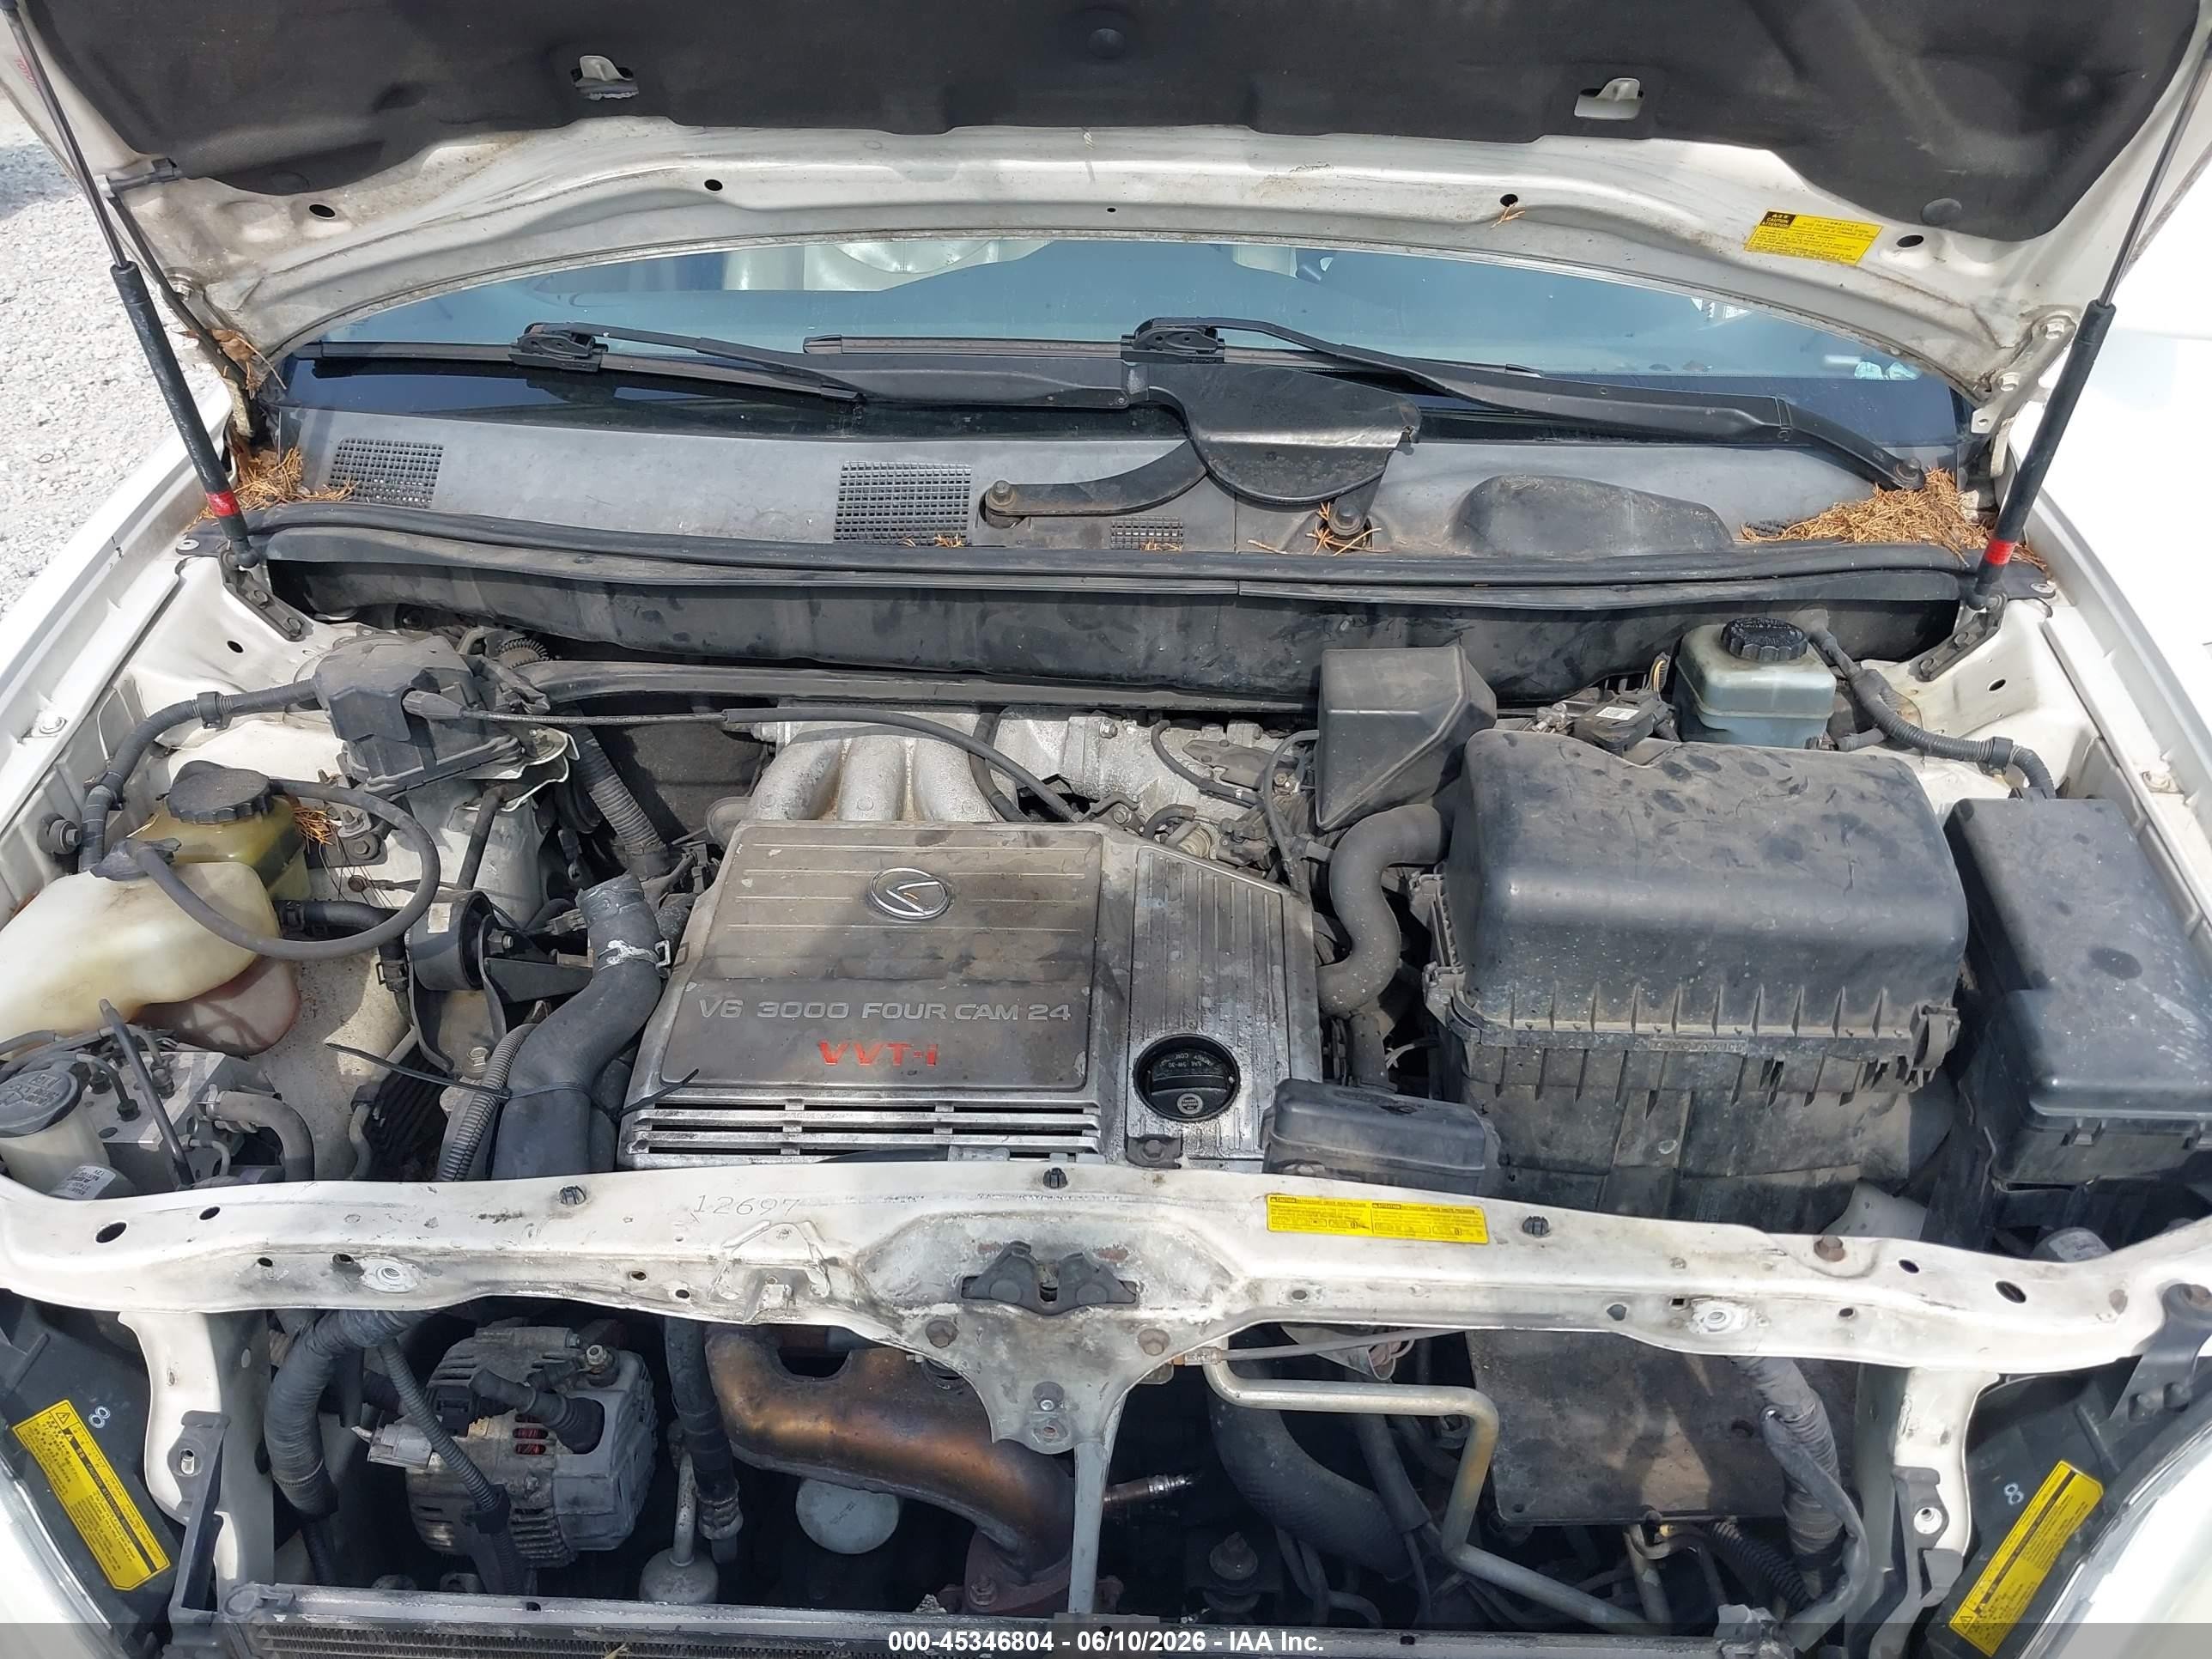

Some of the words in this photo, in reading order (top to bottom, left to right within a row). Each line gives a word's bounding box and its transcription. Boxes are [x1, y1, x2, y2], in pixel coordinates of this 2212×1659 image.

[699, 999, 744, 1018] V6
[757, 1000, 850, 1020] 3000
[861, 1001, 946, 1020] FOUR
[954, 1002, 1019, 1021] CAM
[1028, 1003, 1072, 1022] 24
[693, 1194, 800, 1217] 12697
